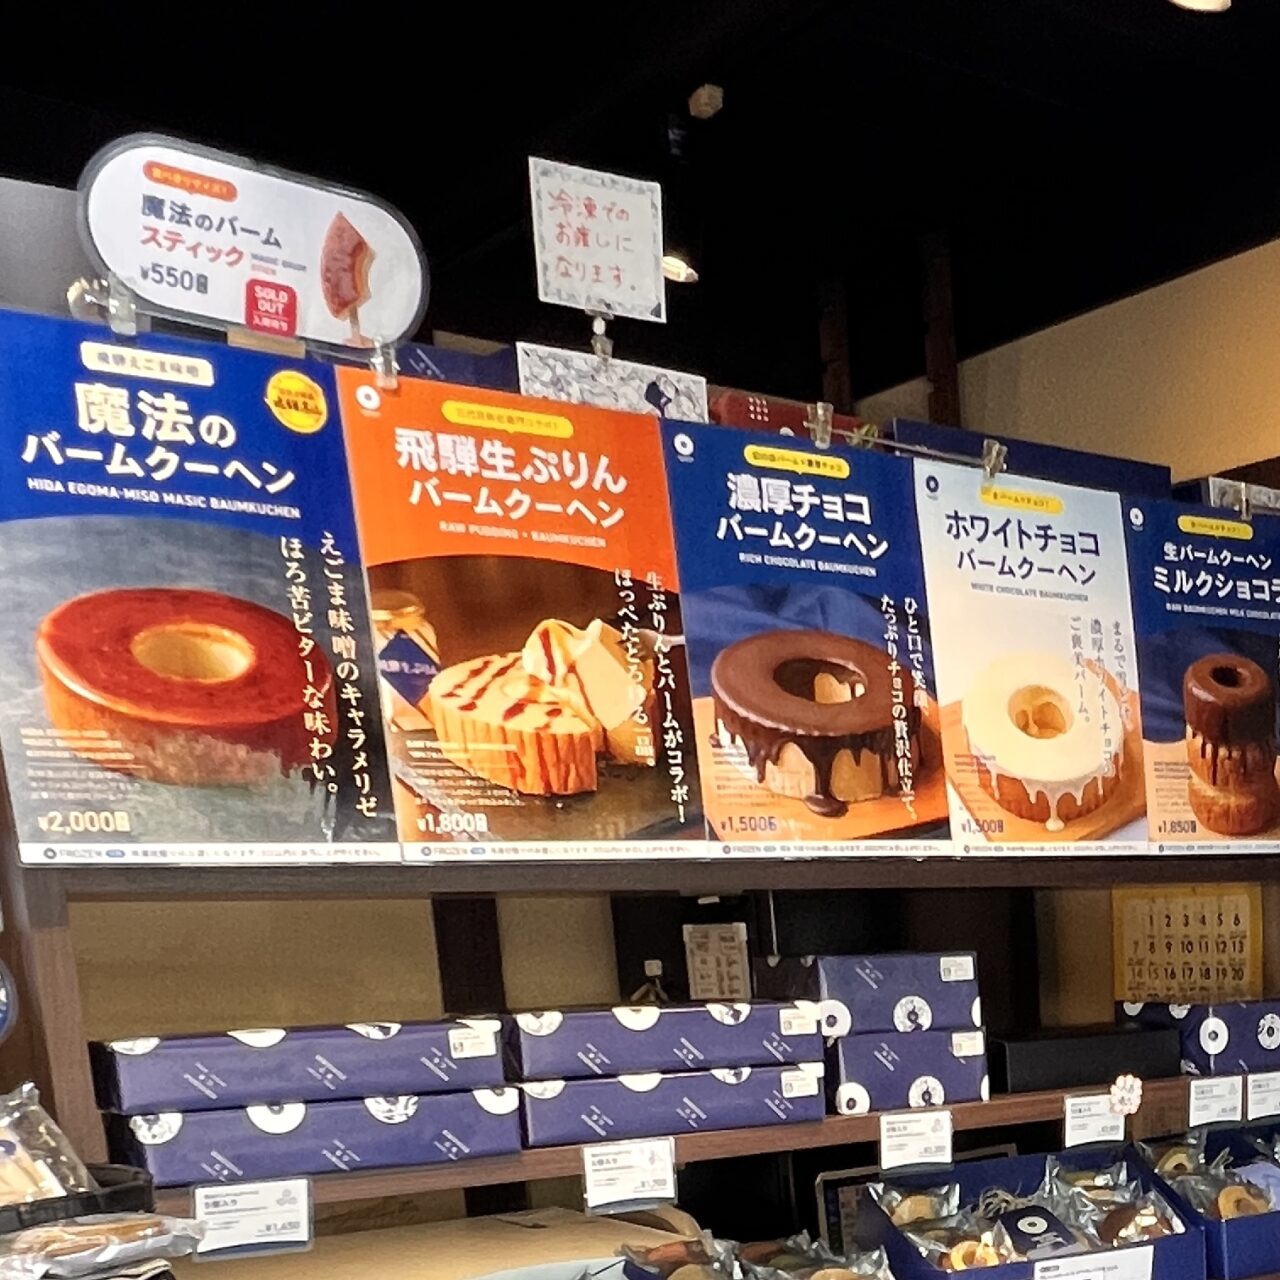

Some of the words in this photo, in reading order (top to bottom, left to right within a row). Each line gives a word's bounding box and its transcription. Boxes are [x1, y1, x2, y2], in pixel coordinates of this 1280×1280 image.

[141, 194, 282, 248] 魔法のバーム
[141, 225, 244, 267] スティック
[254, 285, 288, 303] SOLD
[258, 300, 285, 314] OUT
[74, 382, 236, 448] 魔法の
[21, 431, 295, 494] バームクーヘン
[394, 427, 627, 494] 飛騨生ぷりん
[27, 478, 64, 492] HIDA
[210, 498, 301, 518] BAUMKUCHEN
[409, 478, 624, 528] バームクーヘン
[727, 472, 872, 525] 濃厚チョコ
[716, 513, 889, 560] バームクーヘン
[945, 510, 1100, 557] ホワイトチョコ
[957, 549, 1095, 586] バームクーヘン
[1163, 541, 1272, 571] 生バームクーヘン
[320, 530, 379, 818] えごま味噌のキャラメリゼ
[1165, 915, 1171, 927] 2
[1183, 914, 1190, 927] 3
[1200, 914, 1206, 926] 4
[1217, 913, 1223, 926] 5
[1234, 913, 1240, 926] 6
[1149, 941, 1156, 953] 8
[1166, 941, 1172, 953] 9
[1181, 941, 1193, 953] 10
[1215, 941, 1227, 953] 12
[1232, 941, 1244, 953] 13
[1164, 968, 1176, 980] 16
[1182, 968, 1193, 980] 17
[1216, 968, 1227, 980] 19
[1232, 968, 1244, 981] 20
